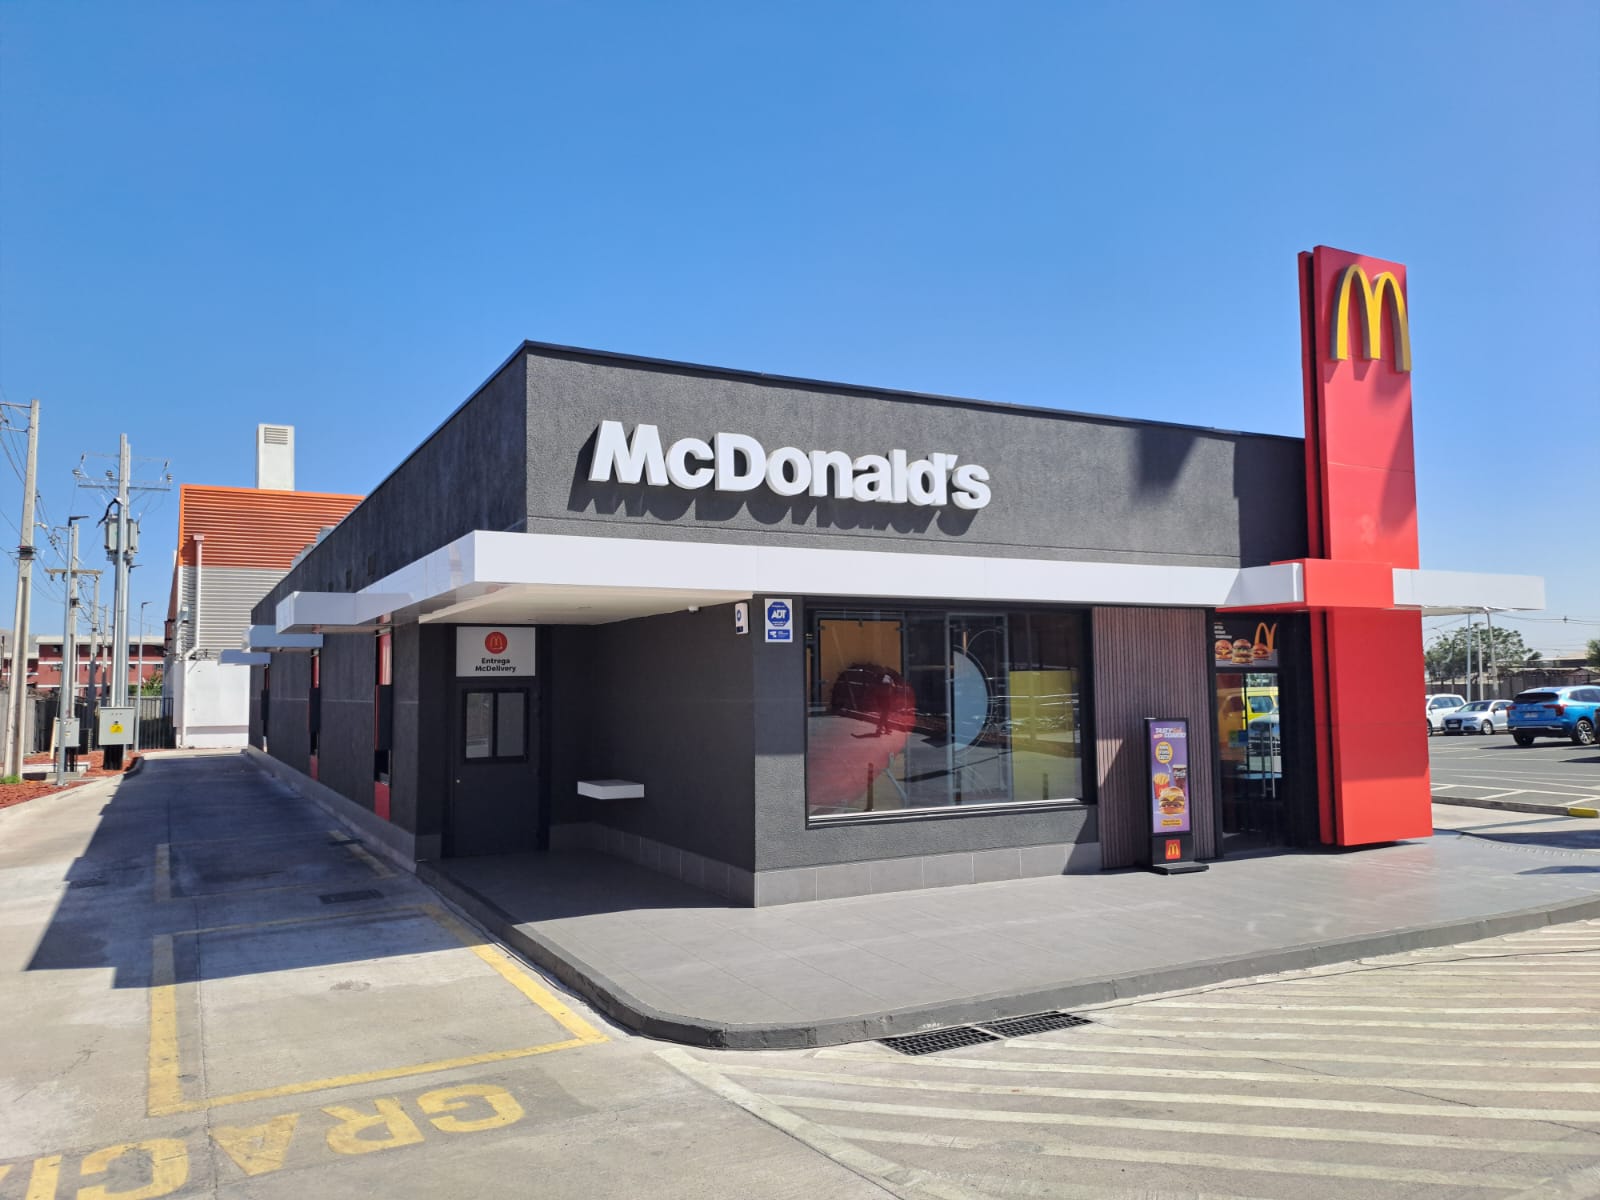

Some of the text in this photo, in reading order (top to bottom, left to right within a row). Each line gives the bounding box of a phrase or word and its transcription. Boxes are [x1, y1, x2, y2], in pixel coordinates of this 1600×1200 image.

[588, 420, 992, 510] McDonald's
[771, 609, 787, 619] ADT
[475, 665, 517, 673] McDelivery
[0, 1084, 526, 1200] GRACI
